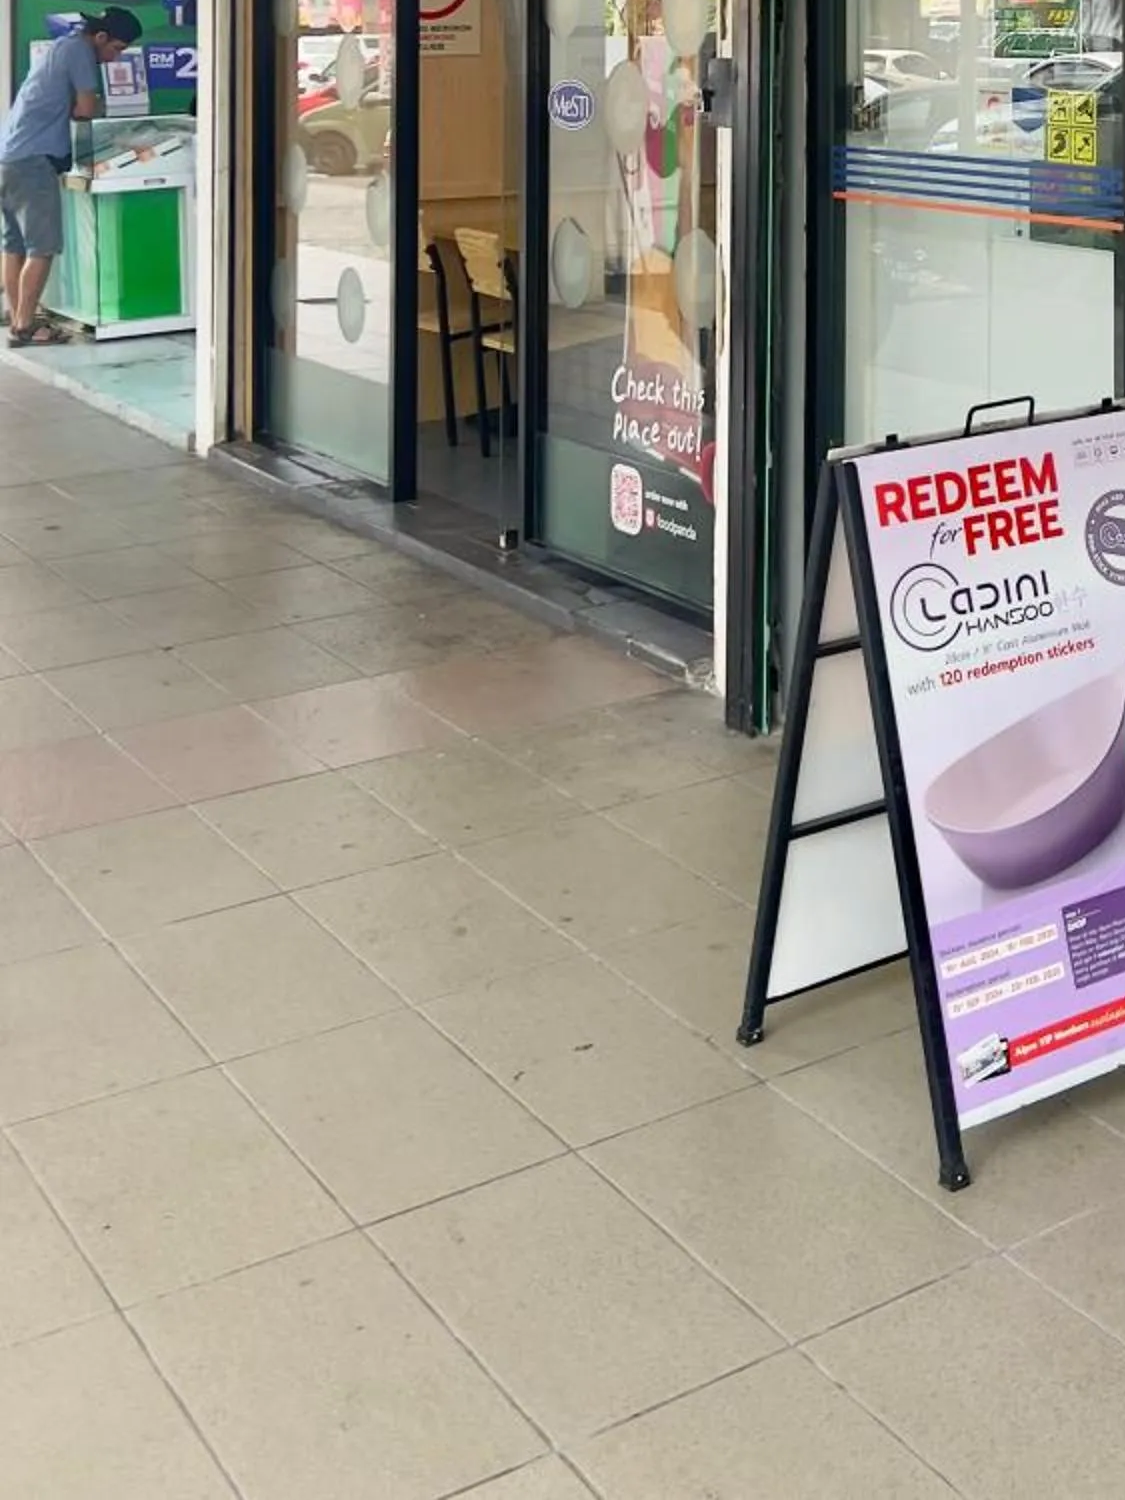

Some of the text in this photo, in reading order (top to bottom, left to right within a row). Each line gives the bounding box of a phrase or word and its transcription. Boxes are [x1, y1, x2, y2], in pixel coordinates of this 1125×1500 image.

[150, 53, 175, 67] RM
[611, 365, 705, 412] Check this
[612, 411, 661, 446] Place
[874, 451, 1058, 527] REDEEM
[656, 513, 697, 541] foodpanda
[929, 521, 963, 560] for
[963, 499, 1064, 556] FREE
[965, 601, 1055, 636] HANSOO
[907, 637, 1096, 697] with 120 redemption stickers
